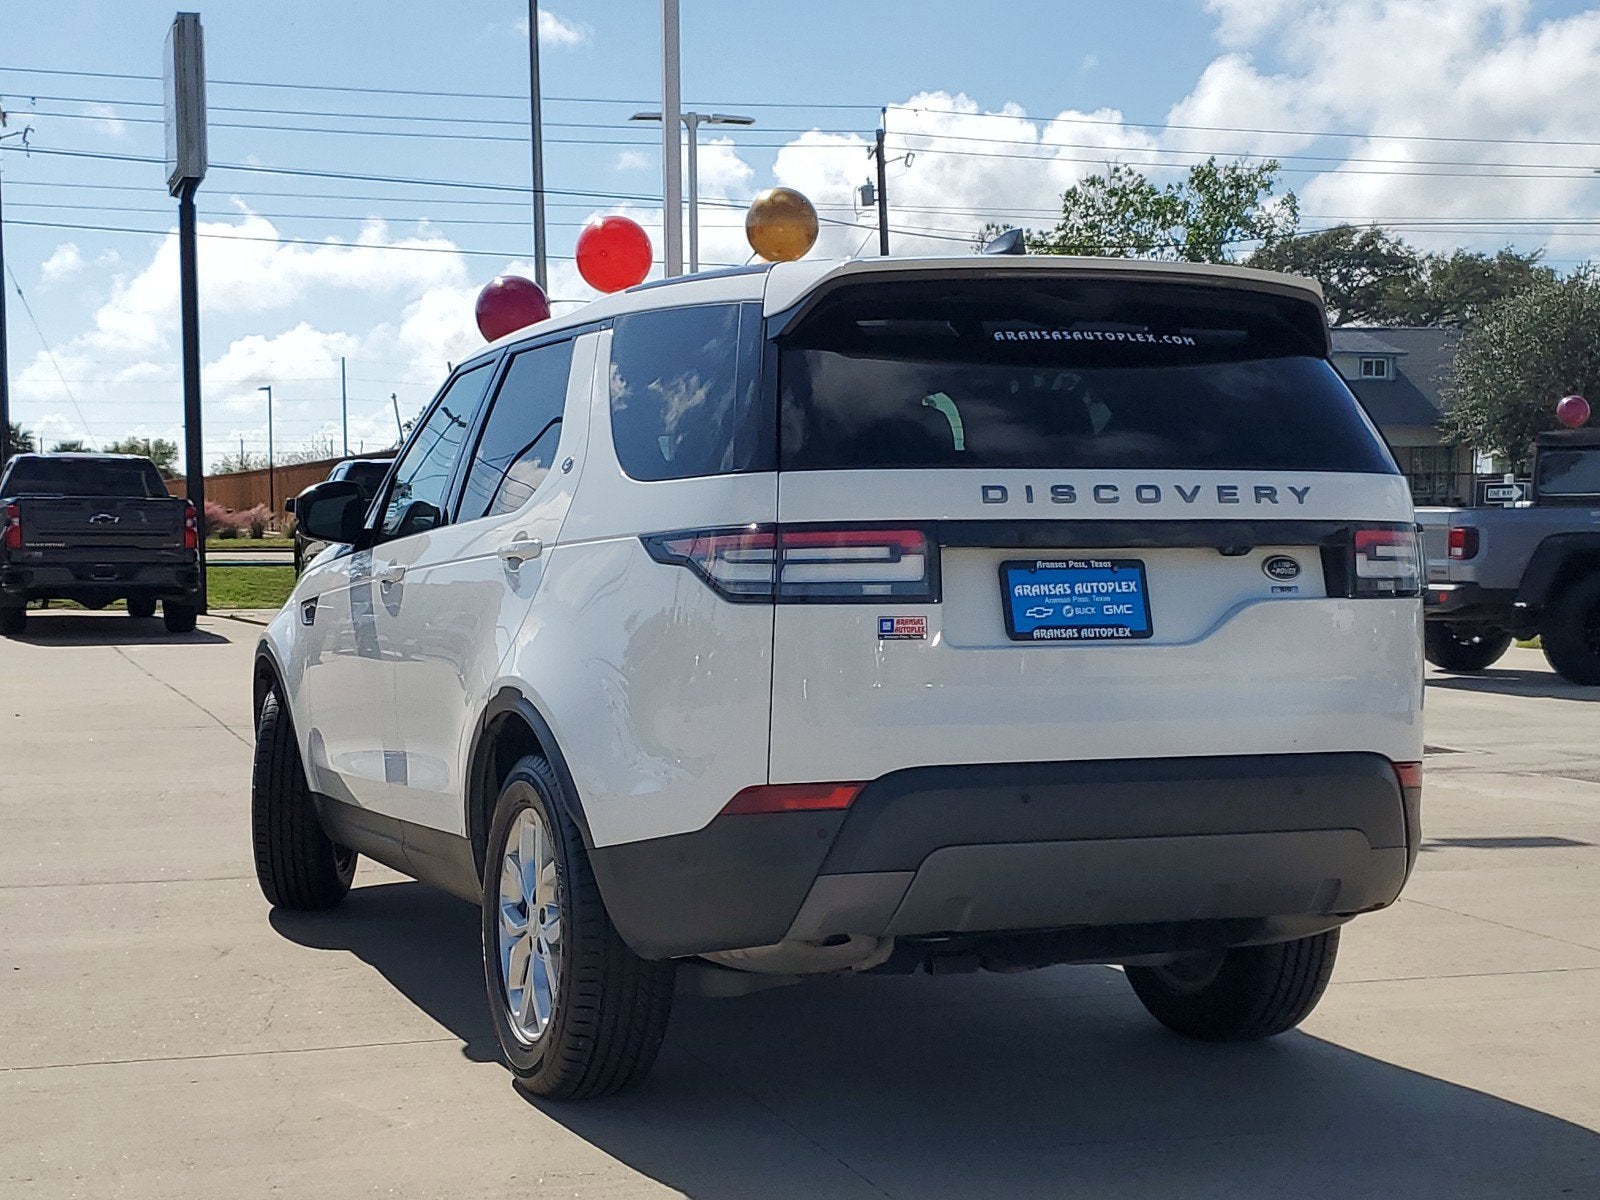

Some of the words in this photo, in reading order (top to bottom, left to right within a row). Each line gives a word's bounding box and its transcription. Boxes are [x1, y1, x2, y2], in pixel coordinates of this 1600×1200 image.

[994, 330, 1196, 346] ARANSASAUTOPLEX.COM
[981, 484, 1311, 505] DISCOVERY
[1036, 561, 1067, 569] Aransas
[1068, 560, 1088, 569] Pass,
[1091, 560, 1112, 568] Texas
[1014, 583, 1071, 597] ARANSAS
[1074, 581, 1138, 595] AUTOPLEX
[1075, 607, 1096, 615] BUICK
[1103, 605, 1133, 615] GMC
[896, 618, 924, 626] ARANSAS
[1033, 628, 1078, 639] ARANSAS
[1081, 627, 1132, 638] AUTOPLEX
